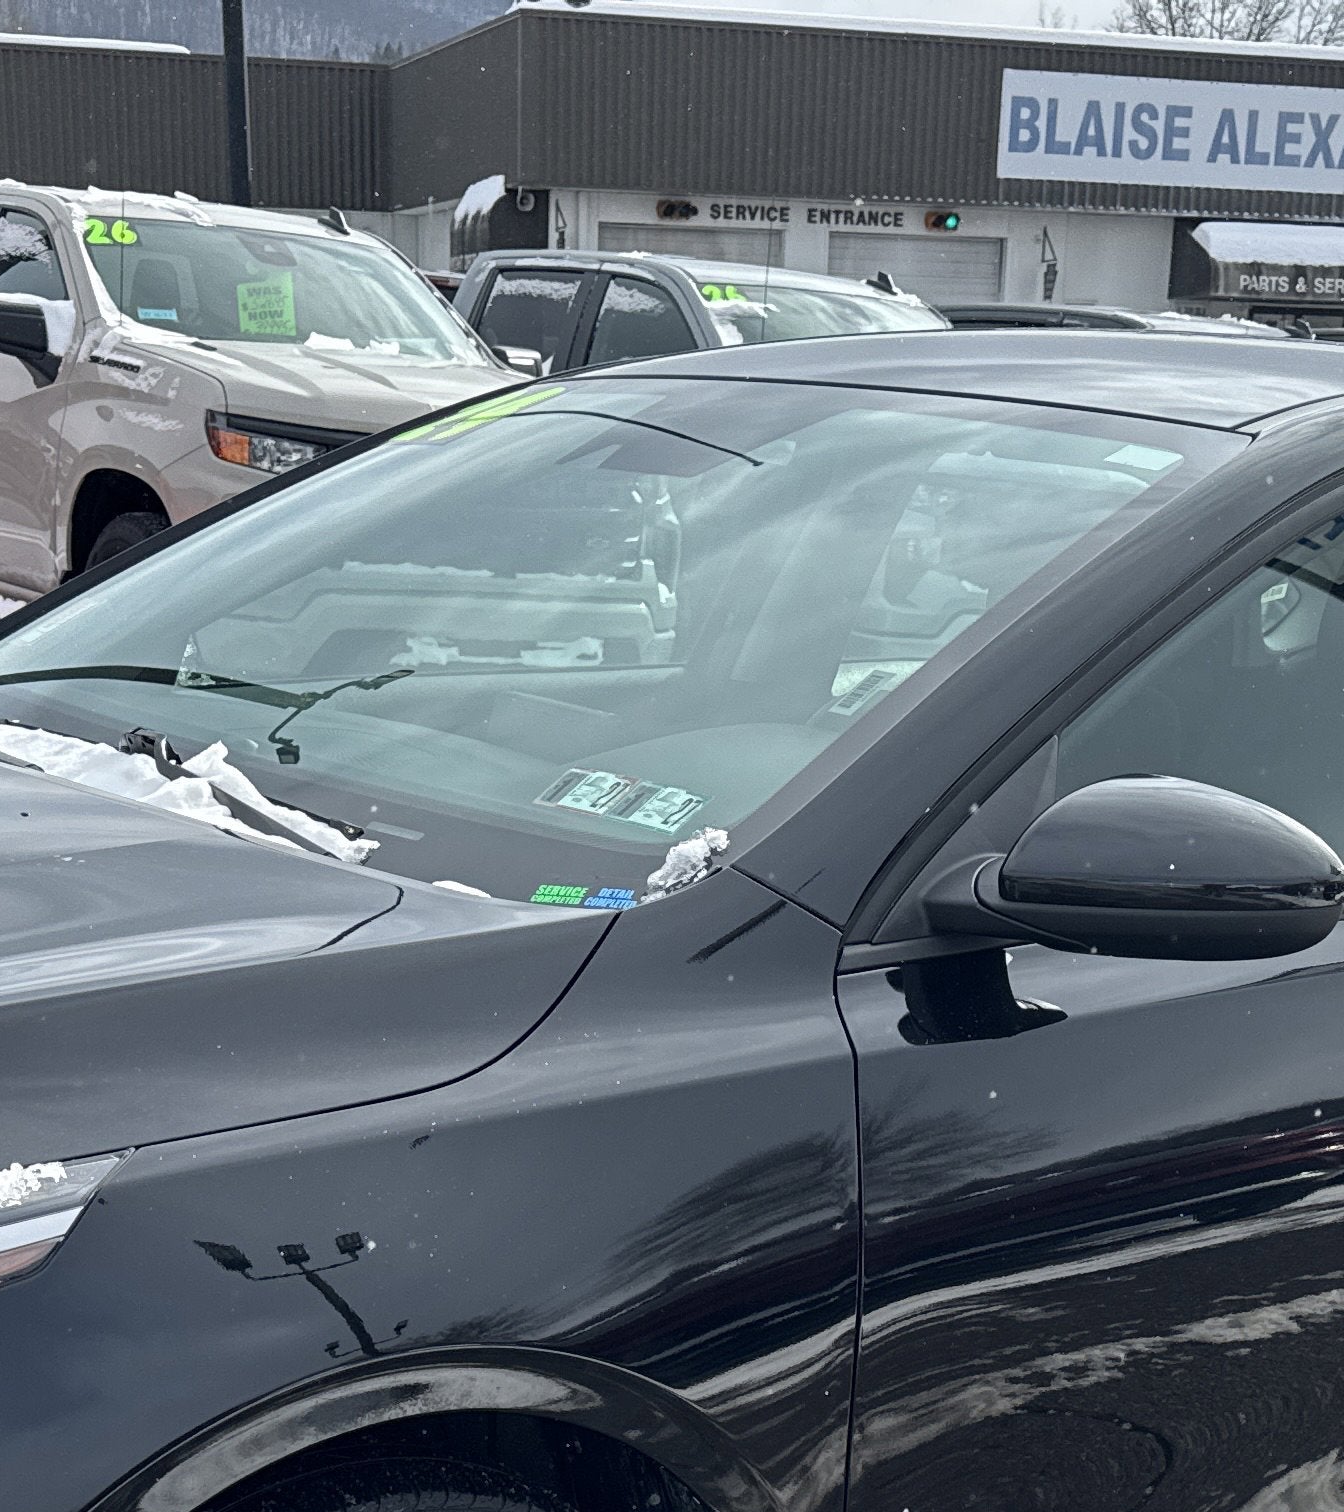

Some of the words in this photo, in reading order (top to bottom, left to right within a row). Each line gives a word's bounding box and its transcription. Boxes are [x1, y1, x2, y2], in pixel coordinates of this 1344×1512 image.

[1008, 95, 1194, 162] BLAISE
[709, 204, 791, 224] SERVICE
[807, 208, 904, 228] ENTRANCE
[84, 218, 138, 245] 26
[1239, 274, 1290, 294] PARTS
[1295, 276, 1308, 294] &
[247, 309, 284, 321] NOW
[536, 884, 590, 898] SERVICE
[598, 887, 635, 900] DETAIL
[530, 894, 582, 905] COMPLETED
[583, 896, 638, 910] COMPLETED
